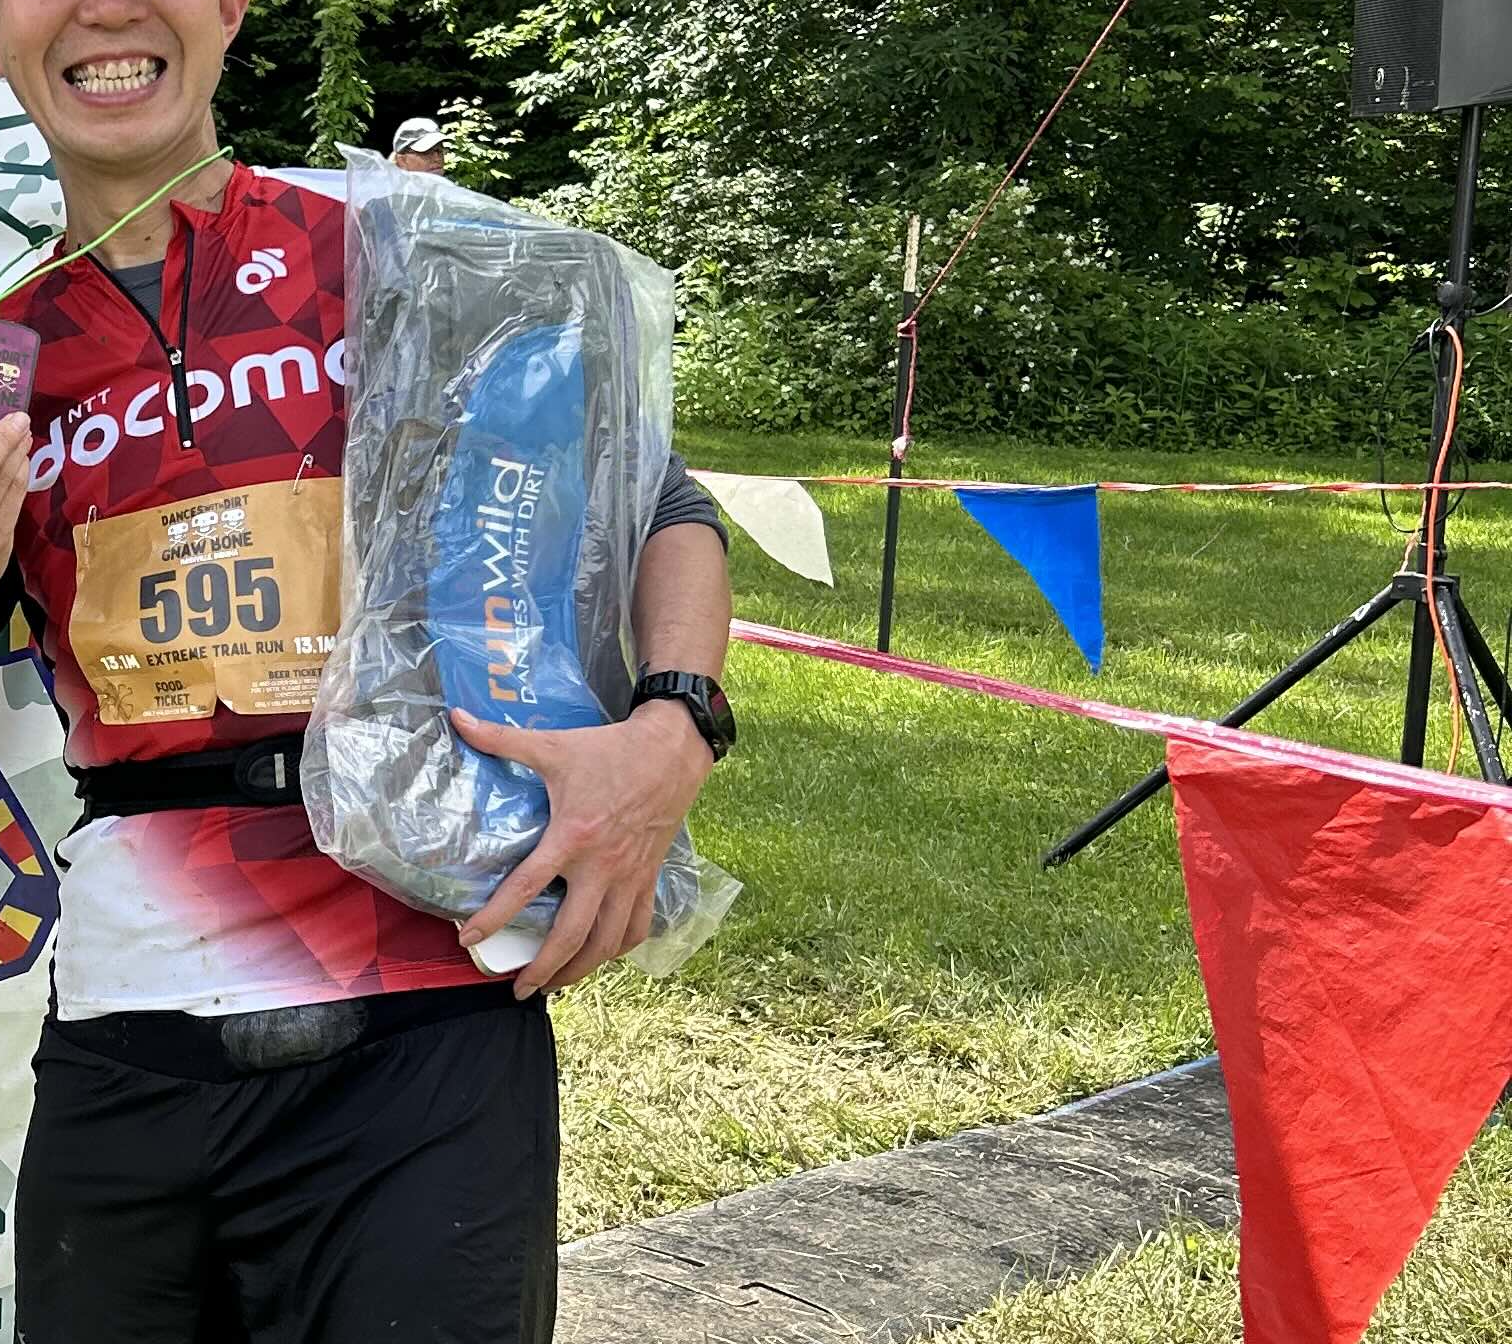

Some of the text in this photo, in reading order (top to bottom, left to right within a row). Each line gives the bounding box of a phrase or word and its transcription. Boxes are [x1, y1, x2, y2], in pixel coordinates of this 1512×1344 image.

[68, 387, 112, 424] NTT
[161, 505, 204, 526] DANCES
[223, 494, 249, 510] DIRT
[517, 463, 546, 521] DIRT
[161, 539, 208, 562] GNAW
[212, 531, 253, 552] BONE
[511, 527, 531, 589] WITH
[139, 557, 282, 644] 595
[99, 635, 338, 672] 13.1M EXTREME TRAIL RUN 13.1M
[511, 598, 539, 706] DANCES
[154, 679, 184, 693] FOOD
[268, 667, 290, 679] BEER
[154, 693, 190, 707] TICKET
